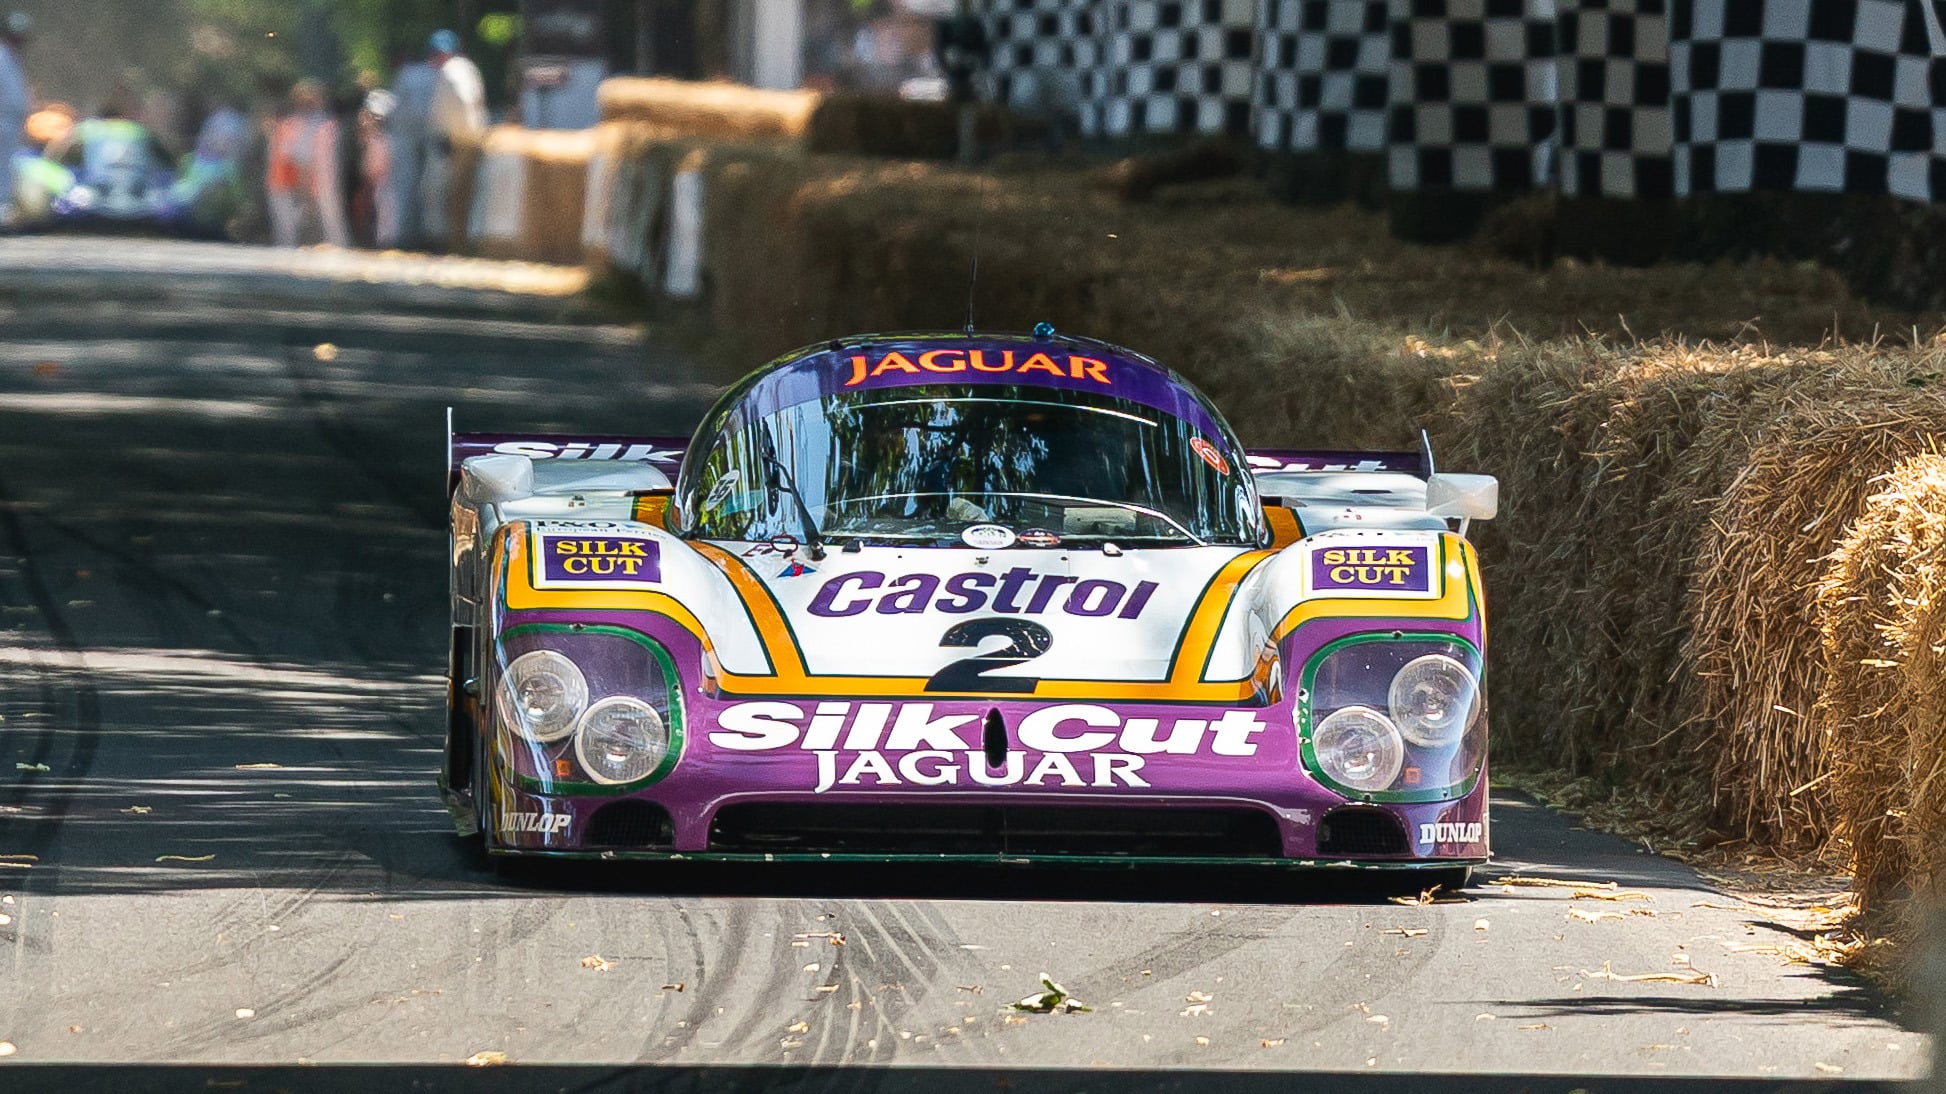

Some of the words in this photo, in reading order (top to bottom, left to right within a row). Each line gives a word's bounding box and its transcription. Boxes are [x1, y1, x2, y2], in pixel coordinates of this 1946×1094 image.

[844, 350, 1112, 386] JAGUAR
[486, 441, 684, 463] Silk
[555, 540, 649, 557] SILK
[1323, 549, 1416, 566] SILK
[562, 556, 643, 575] CUT
[1329, 565, 1411, 585] CUT
[806, 567, 1161, 620] Castrol
[923, 616, 1054, 694] 2
[707, 701, 980, 752] Silk
[1017, 703, 1267, 756] Cut
[814, 750, 1151, 794] JAGUAR
[1419, 822, 1483, 844] DUNLOP
